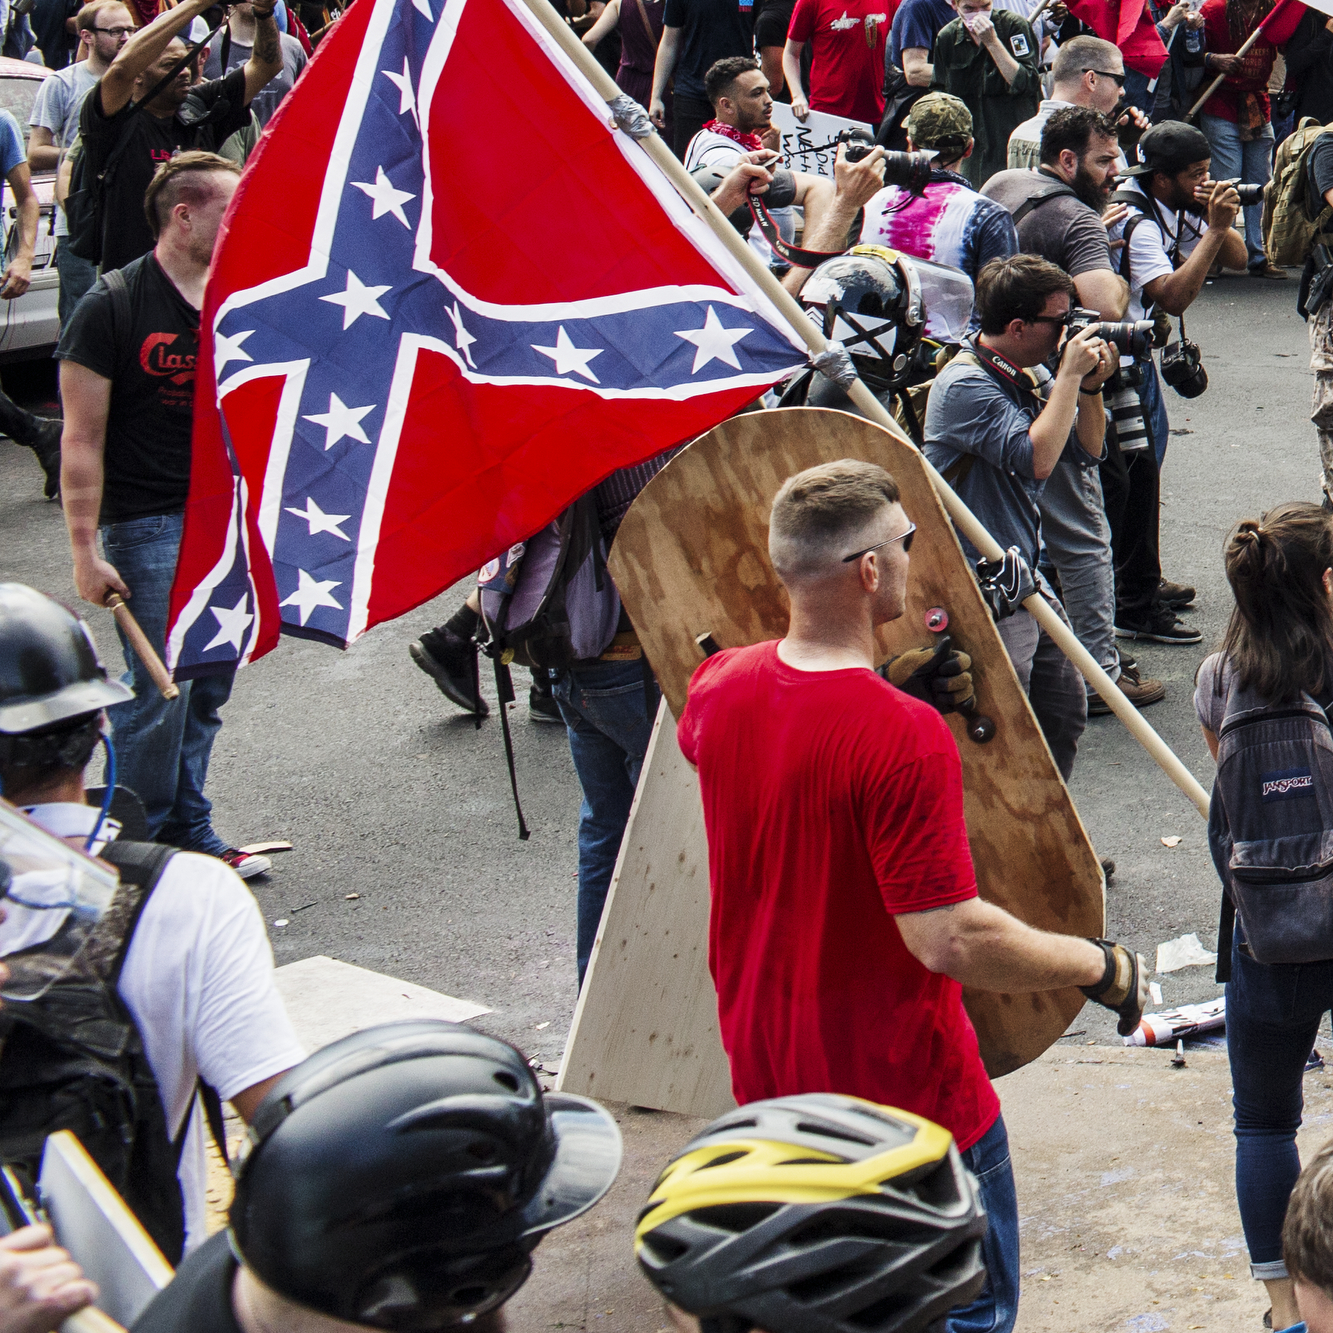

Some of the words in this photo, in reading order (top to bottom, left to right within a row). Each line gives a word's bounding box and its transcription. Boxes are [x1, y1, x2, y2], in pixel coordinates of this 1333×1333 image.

[139, 332, 196, 377] Clas
[992, 356, 1017, 377] Canon
[1262, 776, 1313, 796] JANSPORT
